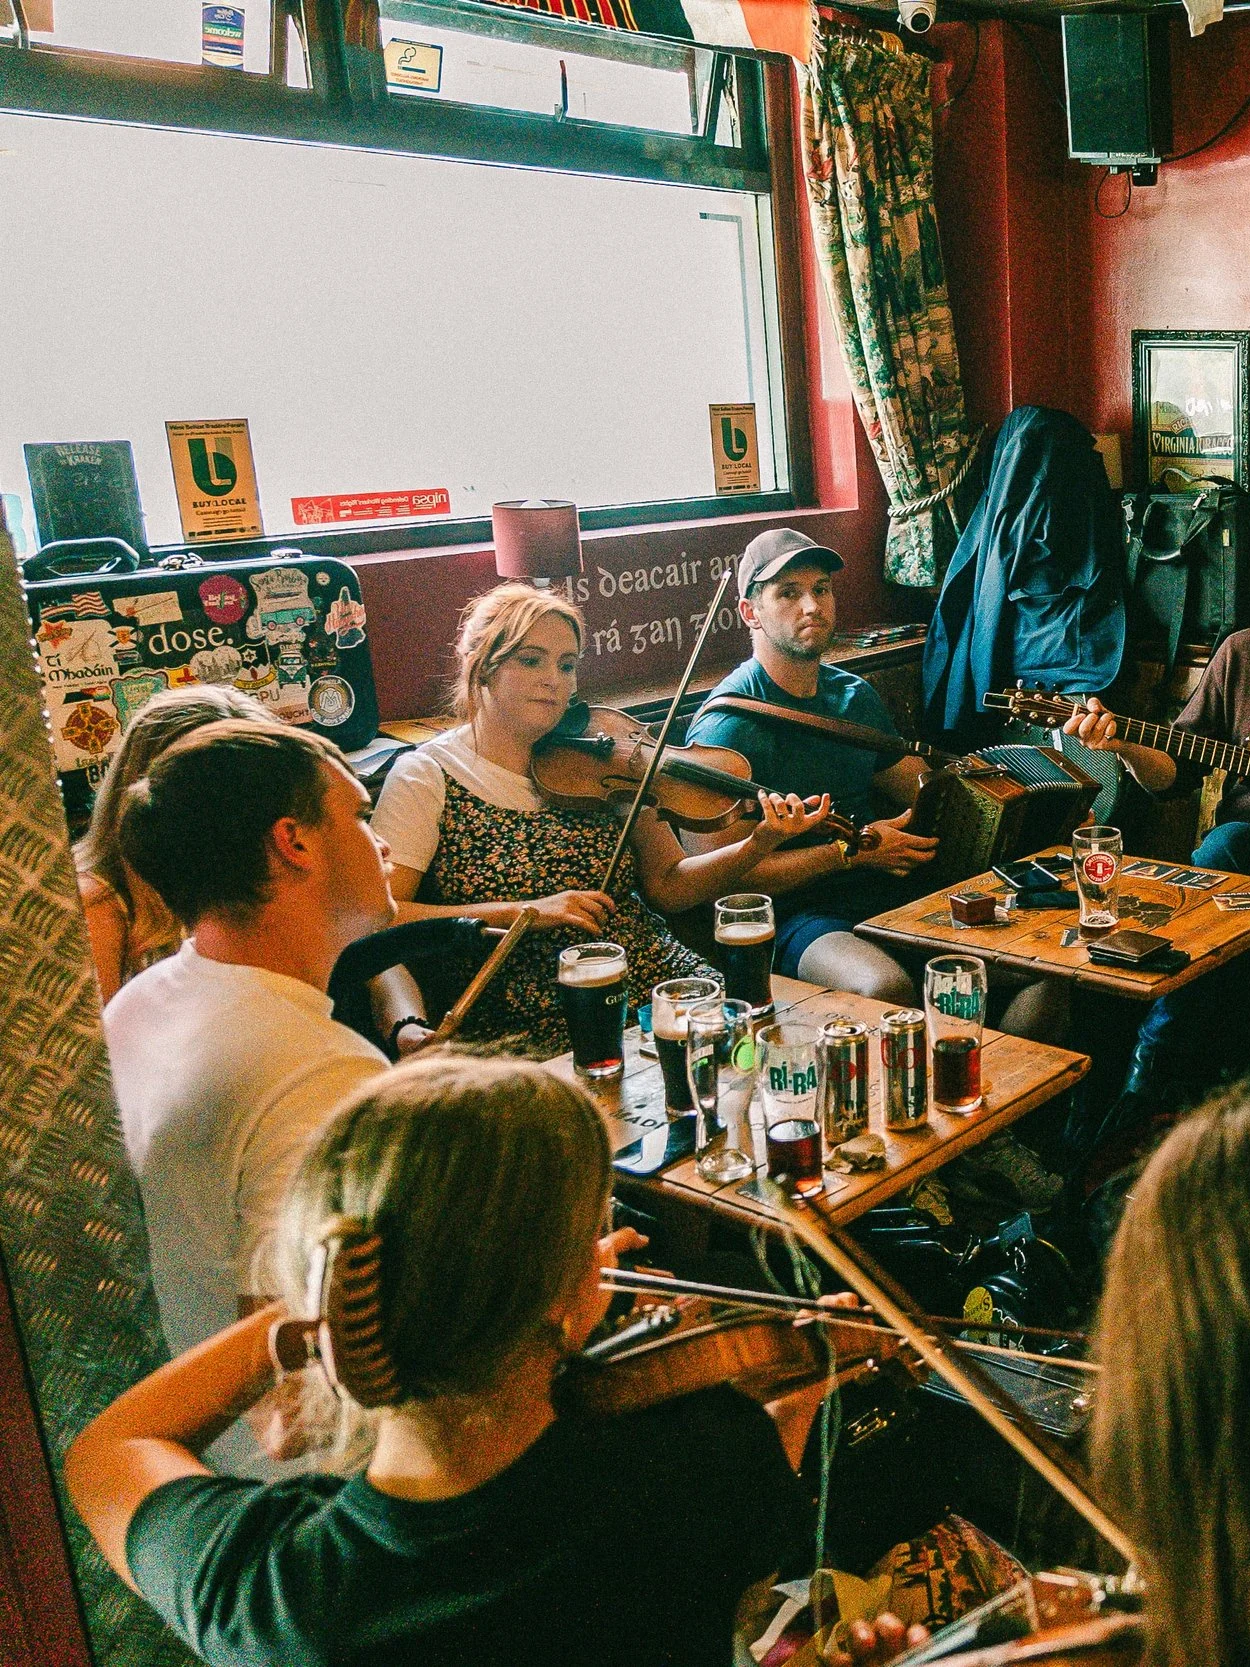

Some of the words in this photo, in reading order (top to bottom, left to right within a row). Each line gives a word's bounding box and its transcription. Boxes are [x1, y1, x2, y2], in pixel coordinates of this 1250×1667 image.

[54, 443, 101, 457] RELEASE
[1152, 432, 1195, 454] VIRGINIA
[67, 455, 103, 466] KRAKEN
[192, 500, 211, 509] BUY
[214, 498, 247, 507] LOCAL
[597, 551, 702, 598] deacair
[149, 625, 234, 656] dose.
[592, 619, 622, 656] rá
[49, 664, 114, 683] Mhadáin
[769, 1060, 818, 1096] RÍ-RÁ
